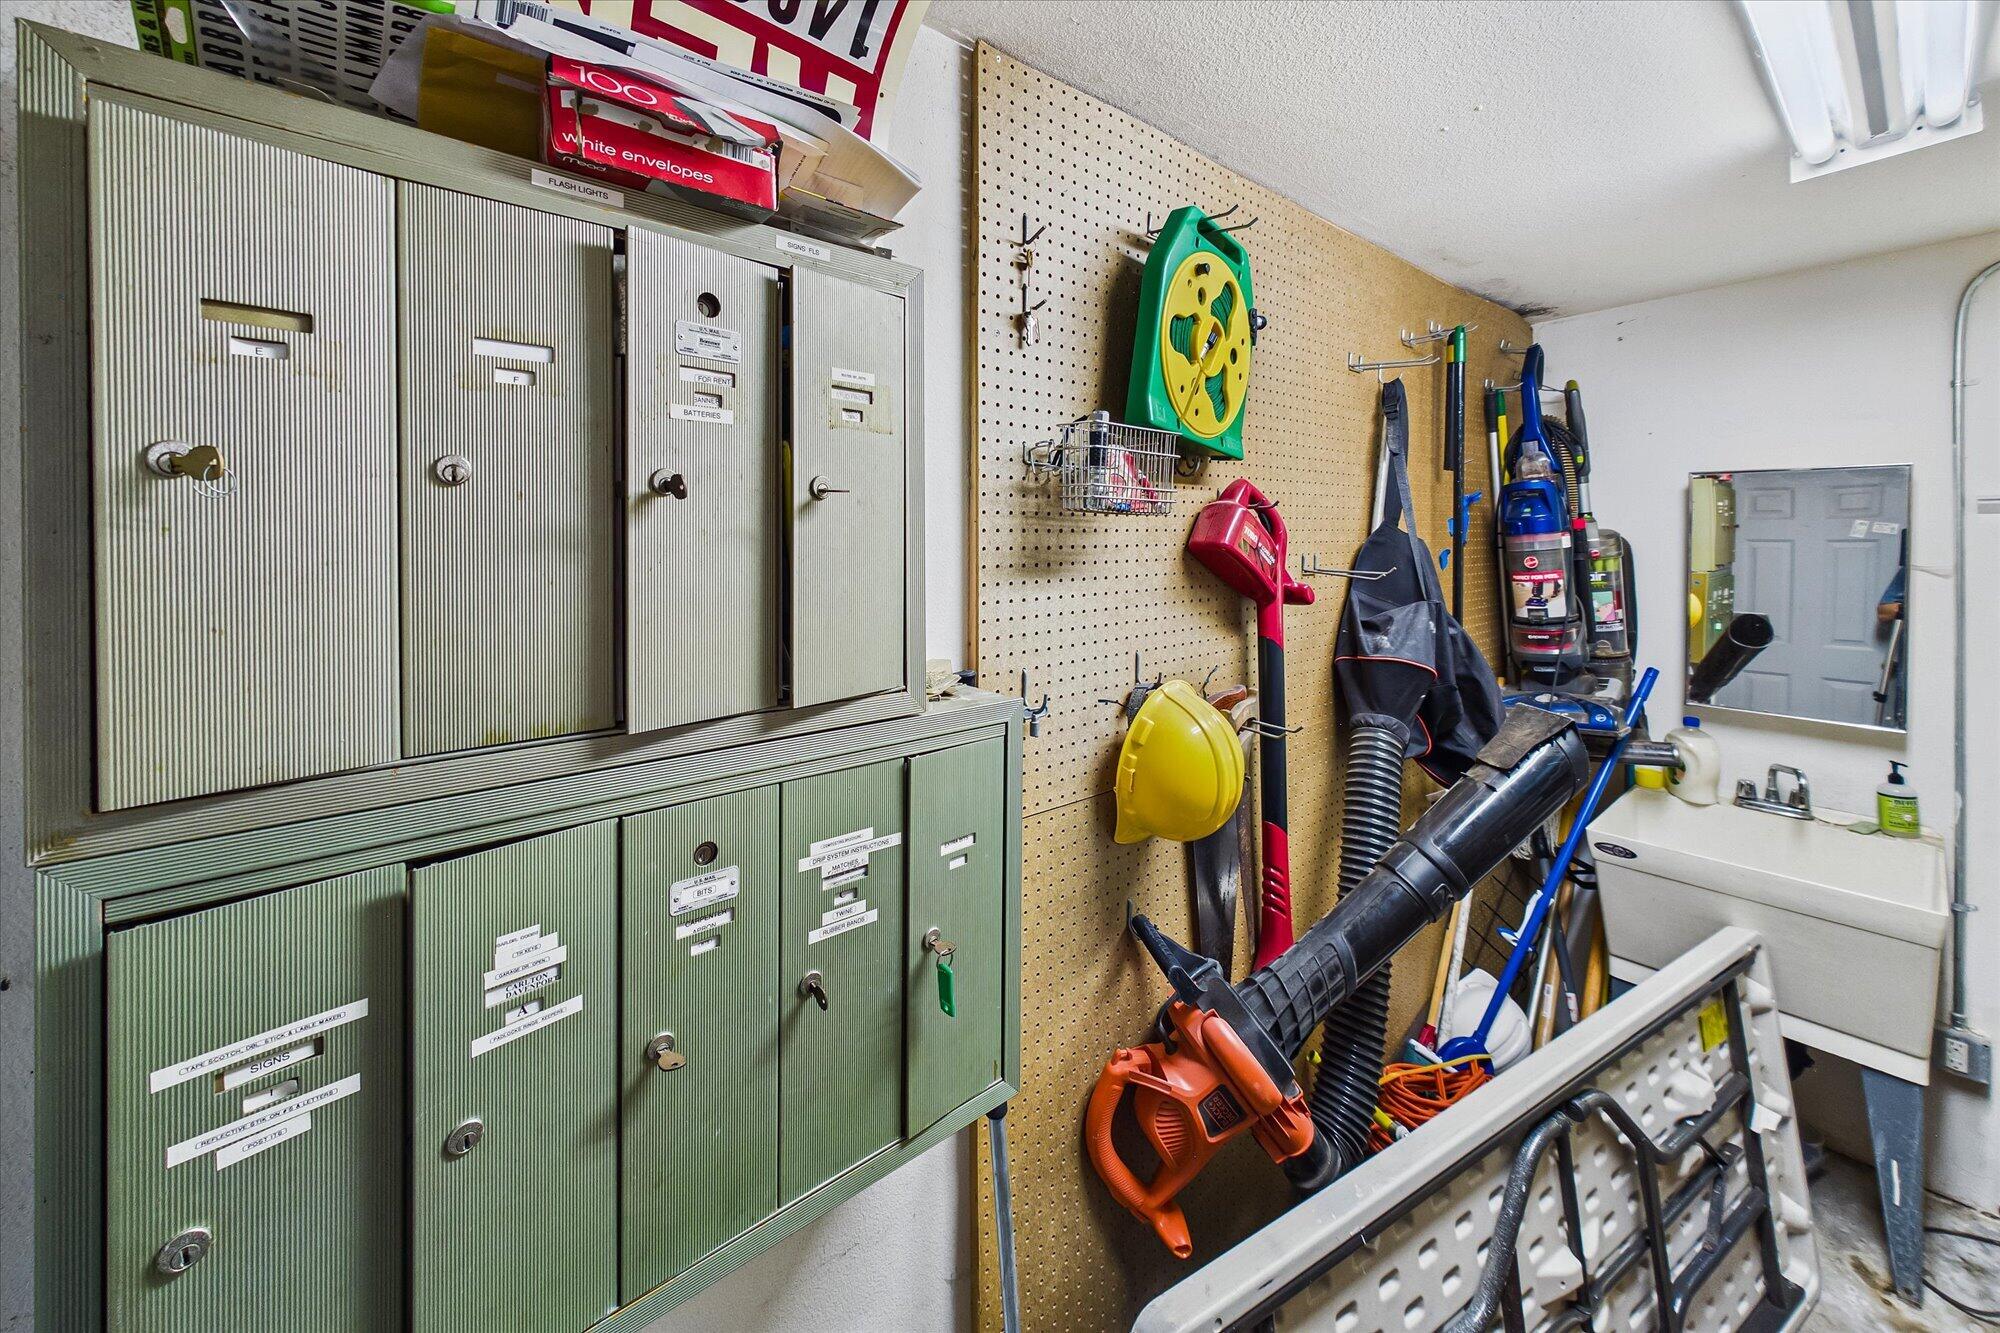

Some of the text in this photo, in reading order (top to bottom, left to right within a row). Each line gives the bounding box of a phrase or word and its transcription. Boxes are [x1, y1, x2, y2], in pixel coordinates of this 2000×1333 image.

[570, 64, 658, 106] 100
[562, 131, 714, 184] white envelopes
[562, 156, 607, 173] mead
[548, 177, 609, 200] FLASH LIGHTS
[787, 241, 806, 253] SIGNS
[255, 346, 264, 356] E
[512, 375, 520, 384] F
[697, 375, 731, 386] FOR RENT
[683, 408, 722, 420] BATTERIES
[812, 838, 890, 866] DRIP SYSTEM INSTRUCTIONS
[831, 858, 859, 871] MATCHES
[697, 886, 713, 897] BITS
[836, 907, 853, 918] TWINE
[822, 916, 866, 936] RUBBER BANDS
[498, 967, 520, 979] GARAGE
[505, 971, 549, 993] CARLTON
[505, 975, 560, 999] DAVENPORT
[517, 1004, 528, 1017] A
[185, 1060, 206, 1073] TAPE
[264, 1033, 286, 1045] STICK
[295, 1022, 317, 1034] LABLE
[319, 1013, 342, 1025] MAKER
[250, 1051, 291, 1074] SIGNS
[199, 1124, 247, 1148] REFLECTIVE
[249, 1115, 267, 1127] STIK
[270, 1110, 281, 1119] ON
[302, 1089, 334, 1107] LETTERS
[248, 1129, 283, 1150] POST ITS
